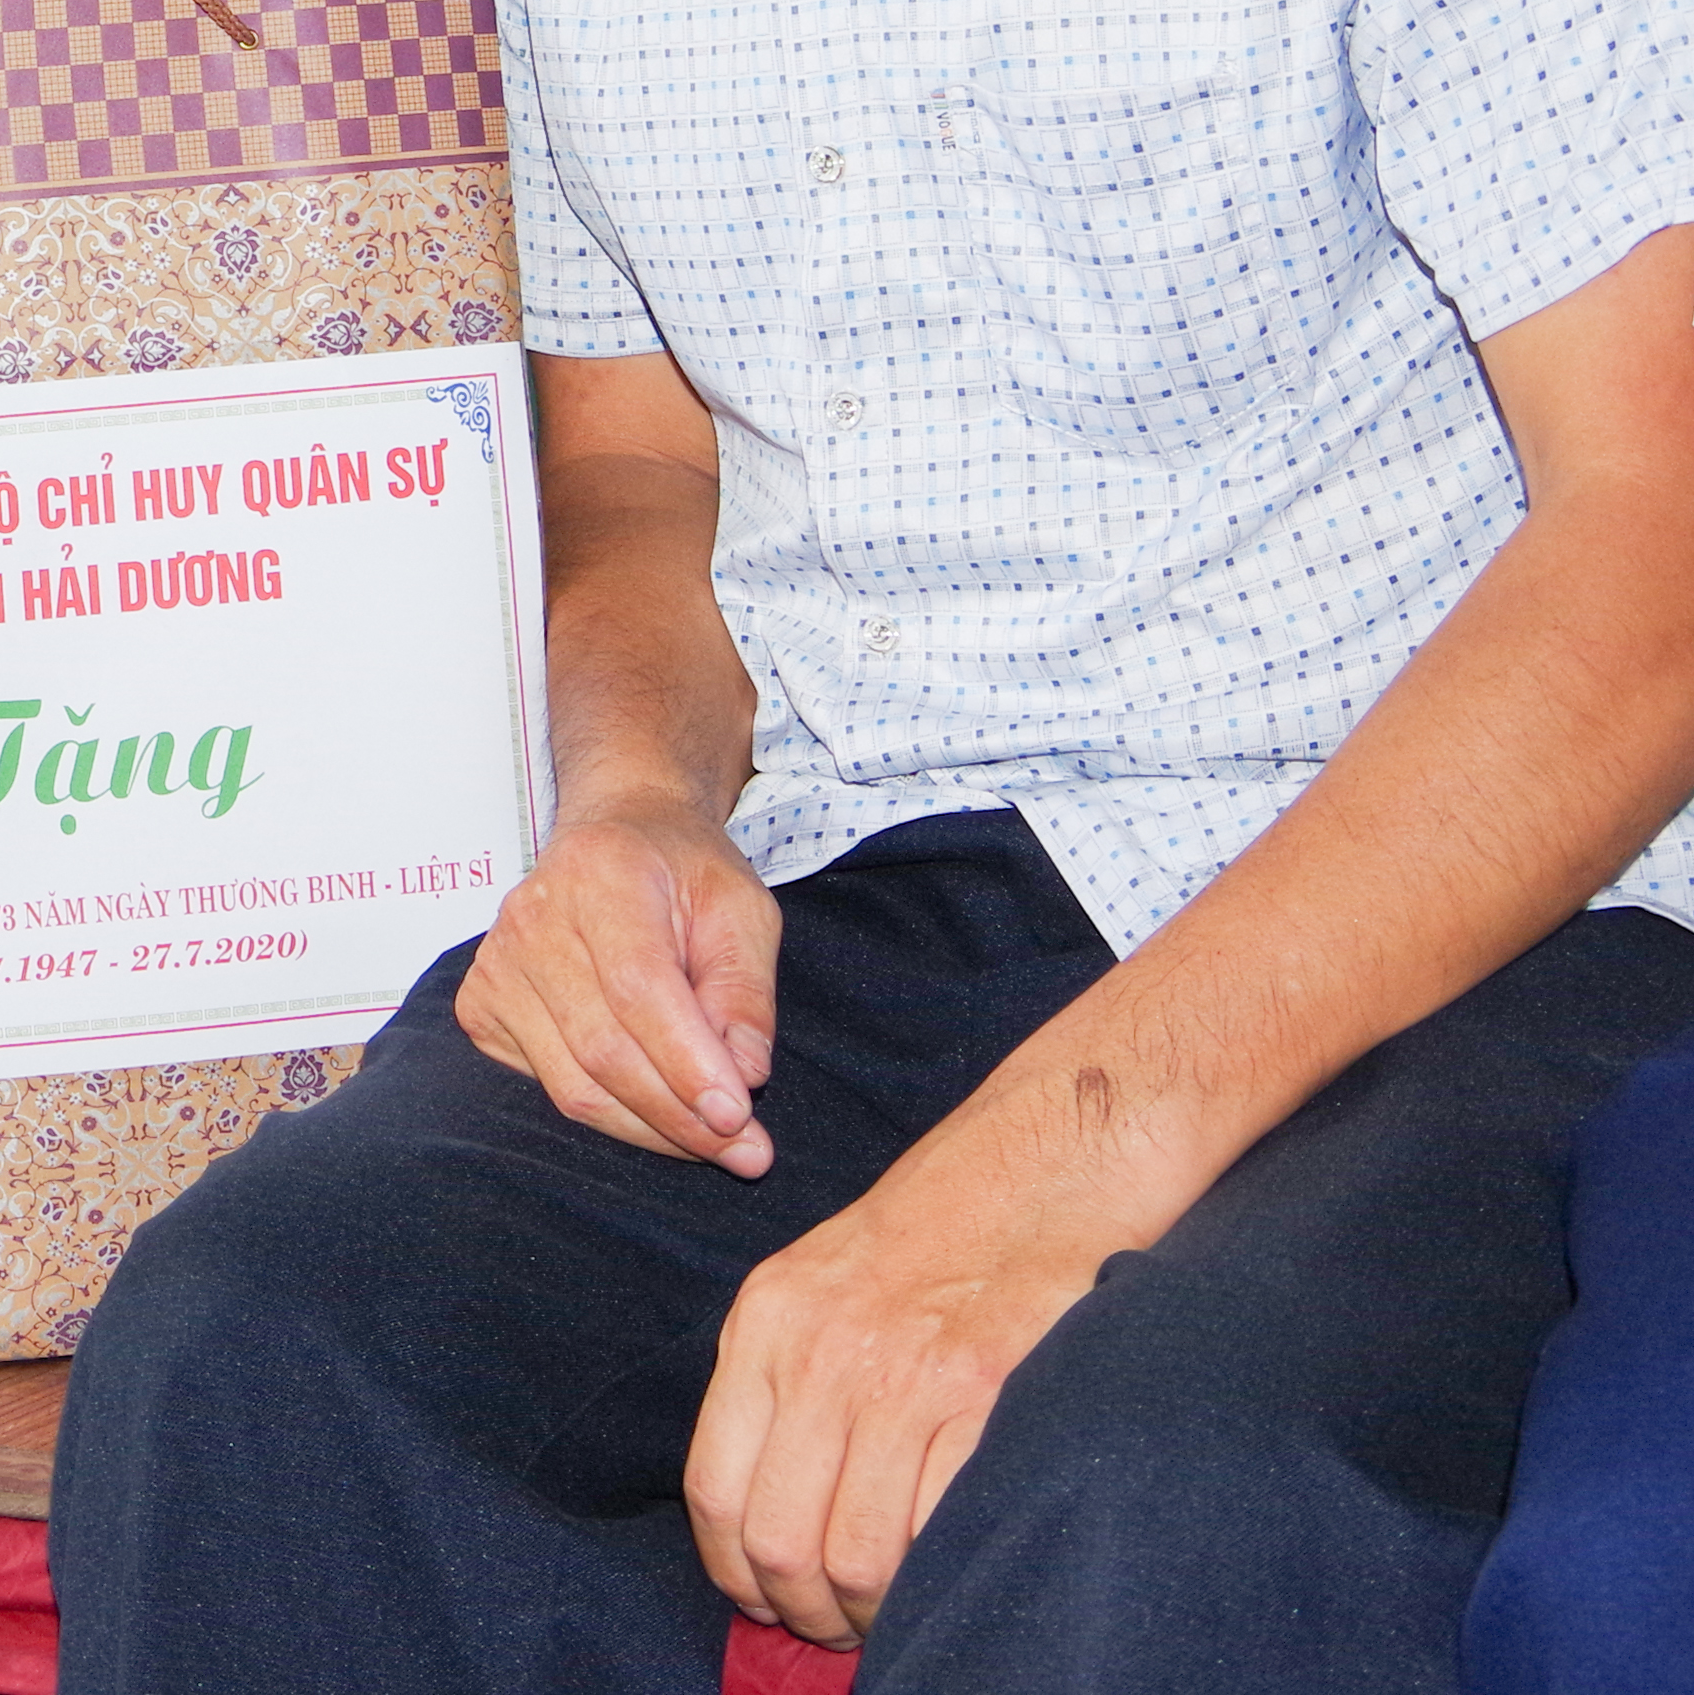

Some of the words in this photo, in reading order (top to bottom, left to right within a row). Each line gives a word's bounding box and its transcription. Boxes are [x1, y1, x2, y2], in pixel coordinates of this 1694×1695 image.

[936, 111, 956, 151] VOGUE
[37, 452, 116, 529] CHỈ
[132, 464, 223, 521] HUY
[242, 443, 370, 517] QUÂN
[386, 438, 448, 507] SỰ
[22, 543, 101, 621] HẢI
[118, 549, 282, 612] DƯƠNG
[24, 890, 87, 929] NĂM
[95, 882, 171, 923] NGÀY
[179, 877, 299, 915] THƯƠNG
[307, 871, 377, 904] BINH
[399, 855, 461, 899] LIỆT
[469, 851, 494, 887] SĨ
[131, 930, 308, 972] 27.7.2020)
